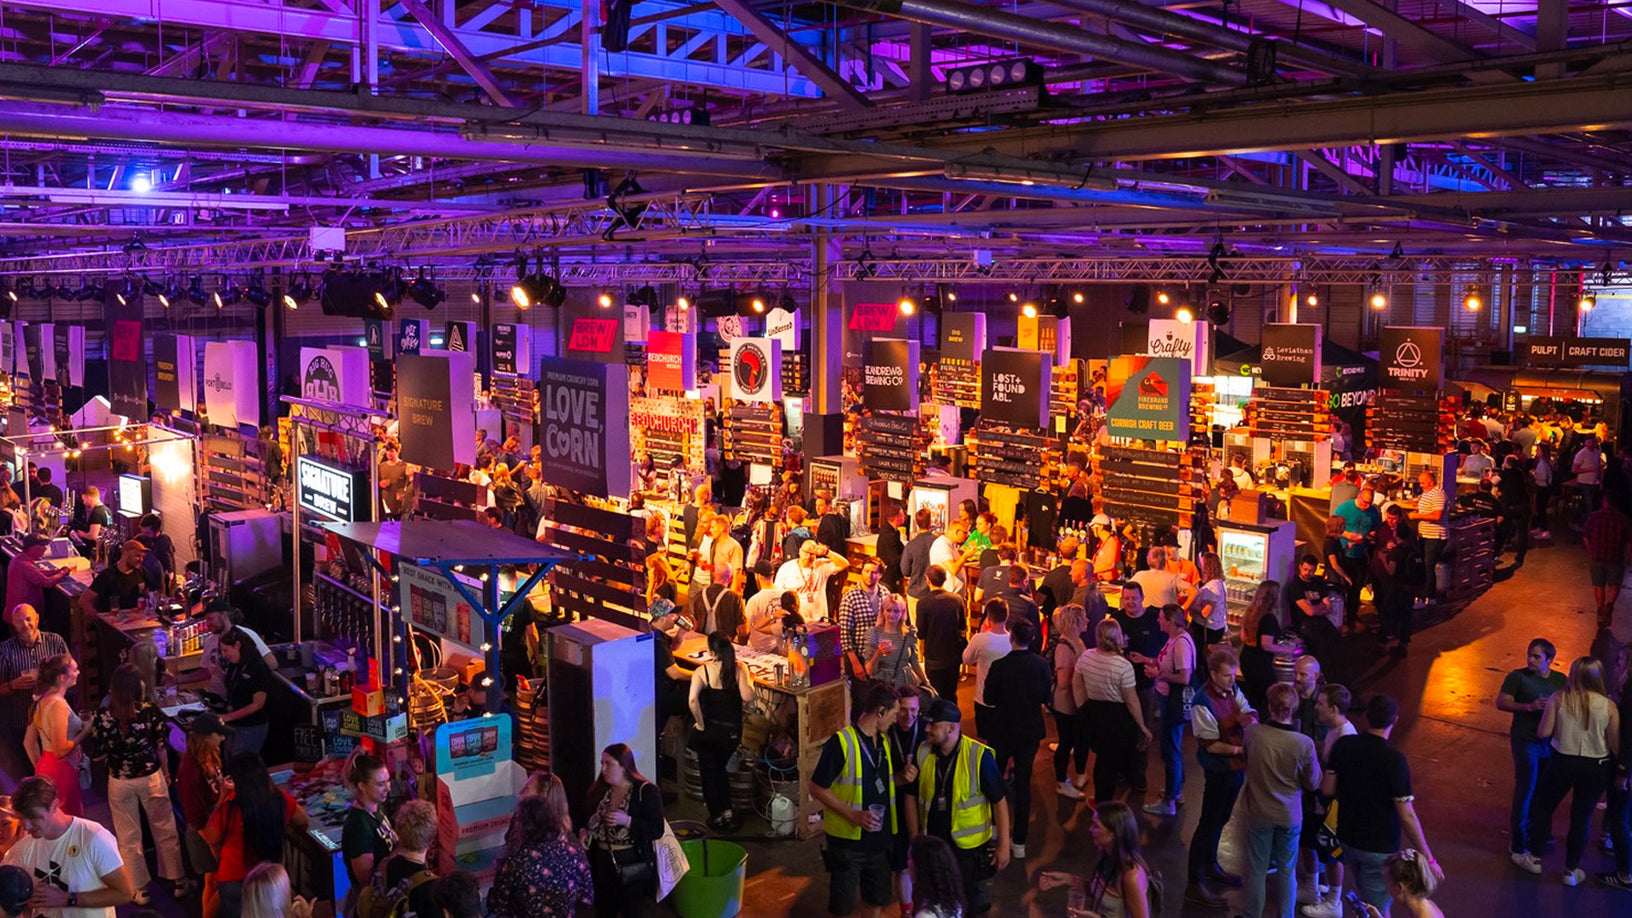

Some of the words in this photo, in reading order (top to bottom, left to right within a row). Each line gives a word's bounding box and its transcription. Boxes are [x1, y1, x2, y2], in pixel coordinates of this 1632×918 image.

[576, 321, 605, 333] BREW
[576, 336, 598, 348] LDN
[1150, 338, 1193, 357] Crafty
[1276, 346, 1313, 355] Leviathan
[1531, 345, 1558, 355] PULPT
[1568, 347, 1597, 357] CRAFT
[1599, 348, 1625, 357] CIDER
[648, 353, 682, 364] REDCHURCH
[1276, 354, 1306, 364] Brewing
[309, 359, 320, 376] BIG
[1388, 367, 1428, 379] TRINITY
[547, 371, 566, 383] PREMIUM
[566, 373, 586, 385] CRUNCHY
[586, 377, 599, 388] CORN
[993, 382, 1026, 395] FOUND
[992, 391, 1012, 403] ABL.
[1138, 396, 1169, 404] FIREBRAND
[1340, 388, 1377, 408] BEYOND
[403, 397, 443, 412] SIGNATURE
[546, 385, 603, 434] LOVE,
[412, 413, 434, 426] BREW
[630, 412, 697, 434] REDCHURCH
[1110, 418, 1138, 429] CORNISH
[1137, 420, 1157, 430] CRAFT
[1158, 421, 1175, 431] BEER
[546, 423, 599, 468] CORN
[313, 494, 338, 514] BREW
[403, 566, 416, 577] BEST
[417, 569, 435, 585] SNACK
[437, 579, 453, 591] WITH
[343, 712, 361, 723] LOVE
[366, 718, 383, 728] LOVE
[294, 727, 318, 747] FREE
[333, 737, 352, 748] LOVE
[461, 821, 490, 834] PREMIUM
[489, 818, 511, 828] CRUNC
